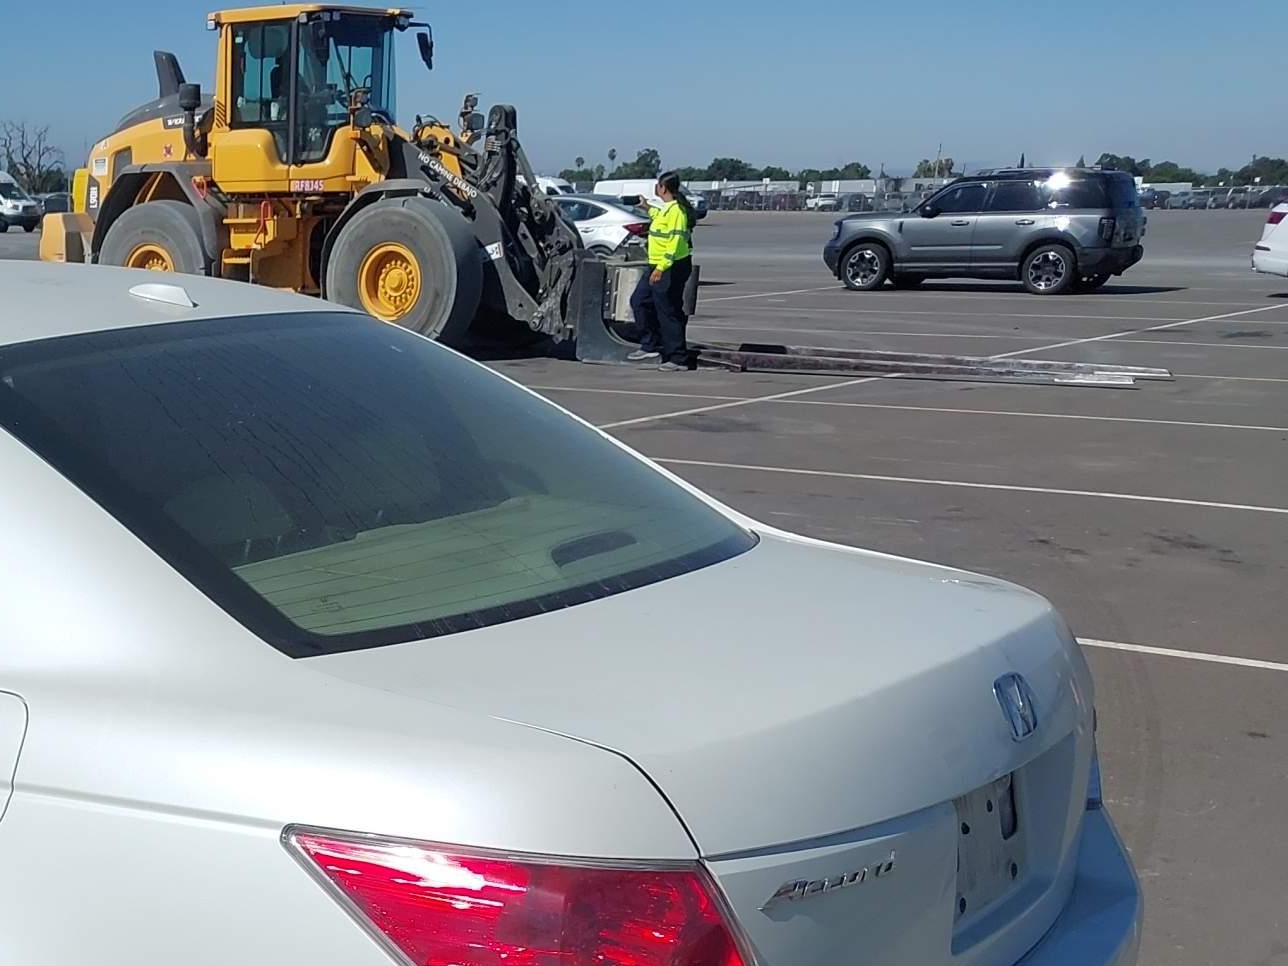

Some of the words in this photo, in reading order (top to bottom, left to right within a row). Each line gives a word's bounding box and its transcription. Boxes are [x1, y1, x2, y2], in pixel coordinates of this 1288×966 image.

[417, 152, 430, 164] NO
[429, 160, 453, 181] CAMINE
[453, 177, 478, 198] DEBAJO
